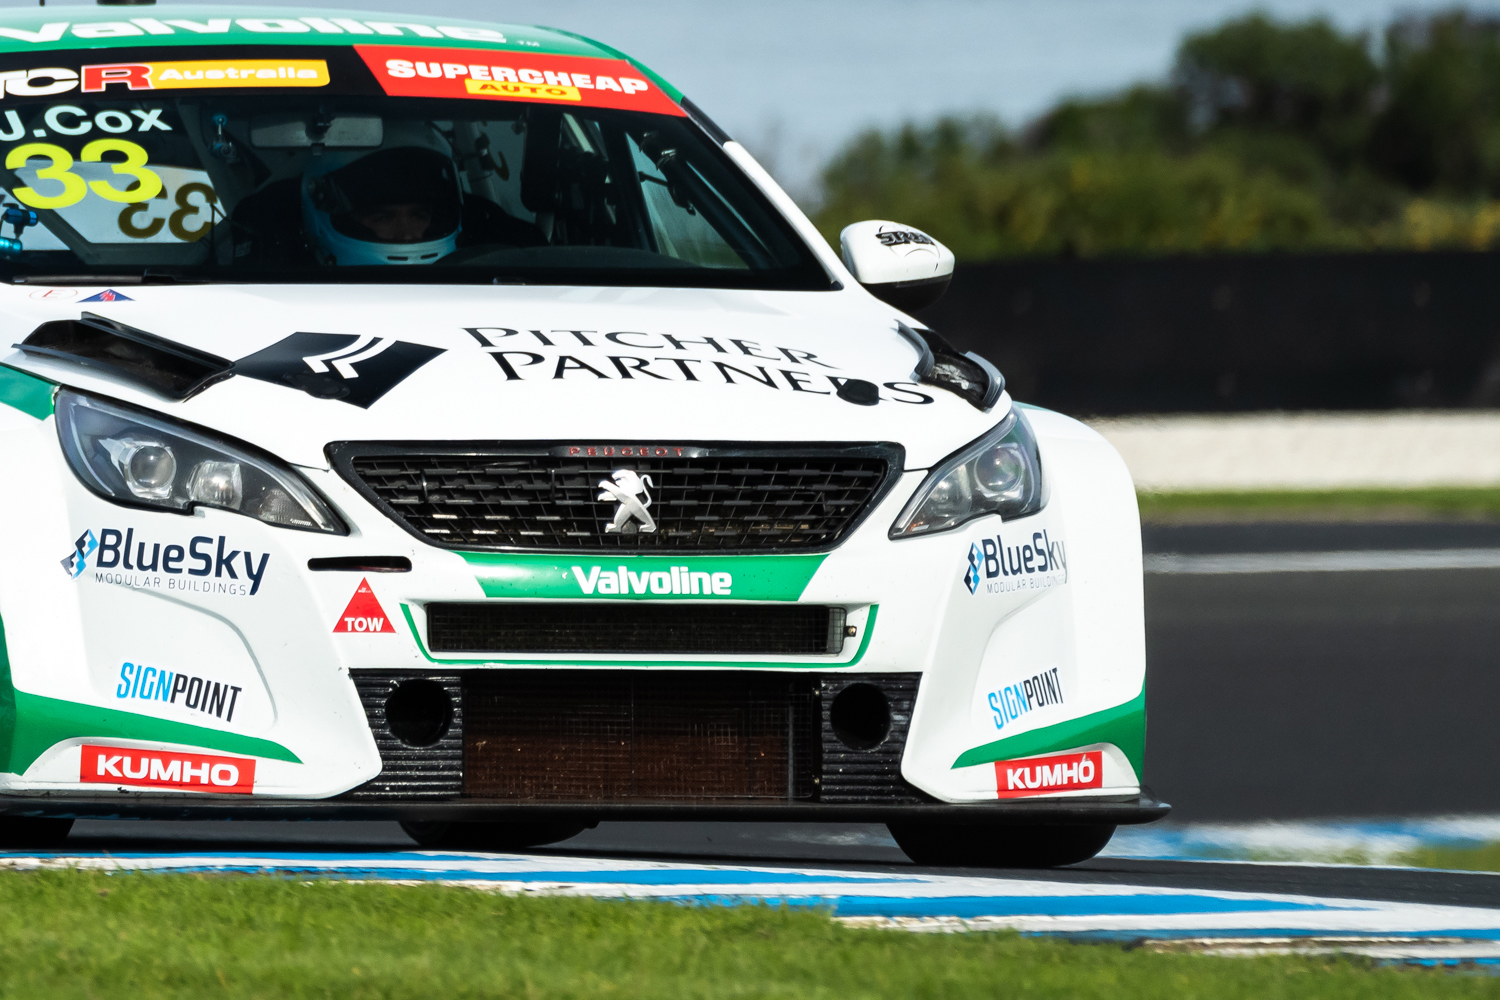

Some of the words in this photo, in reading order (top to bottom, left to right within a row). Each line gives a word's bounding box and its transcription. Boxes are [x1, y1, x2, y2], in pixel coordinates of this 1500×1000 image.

[158, 66, 319, 82] Australia
[385, 58, 650, 95] SUPERCHEAP
[478, 83, 568, 97] AUTO
[5, 138, 163, 209] 33
[461, 326, 842, 370] PITCHER
[569, 447, 684, 457] PEUGEOT
[96, 527, 271, 596] BlueSky
[982, 529, 1068, 585] BlueSky
[95, 572, 161, 588] MODULAR
[169, 578, 247, 596] BUILDINGS
[571, 565, 733, 595] Valvoline
[986, 579, 1028, 595] MODULAR
[344, 617, 385, 632] TOW
[116, 662, 243, 724] SIGNPOINT
[988, 667, 1065, 731] SIGNPOINT
[97, 754, 240, 787] KUMHO
[1007, 760, 1096, 790] KUMHO
